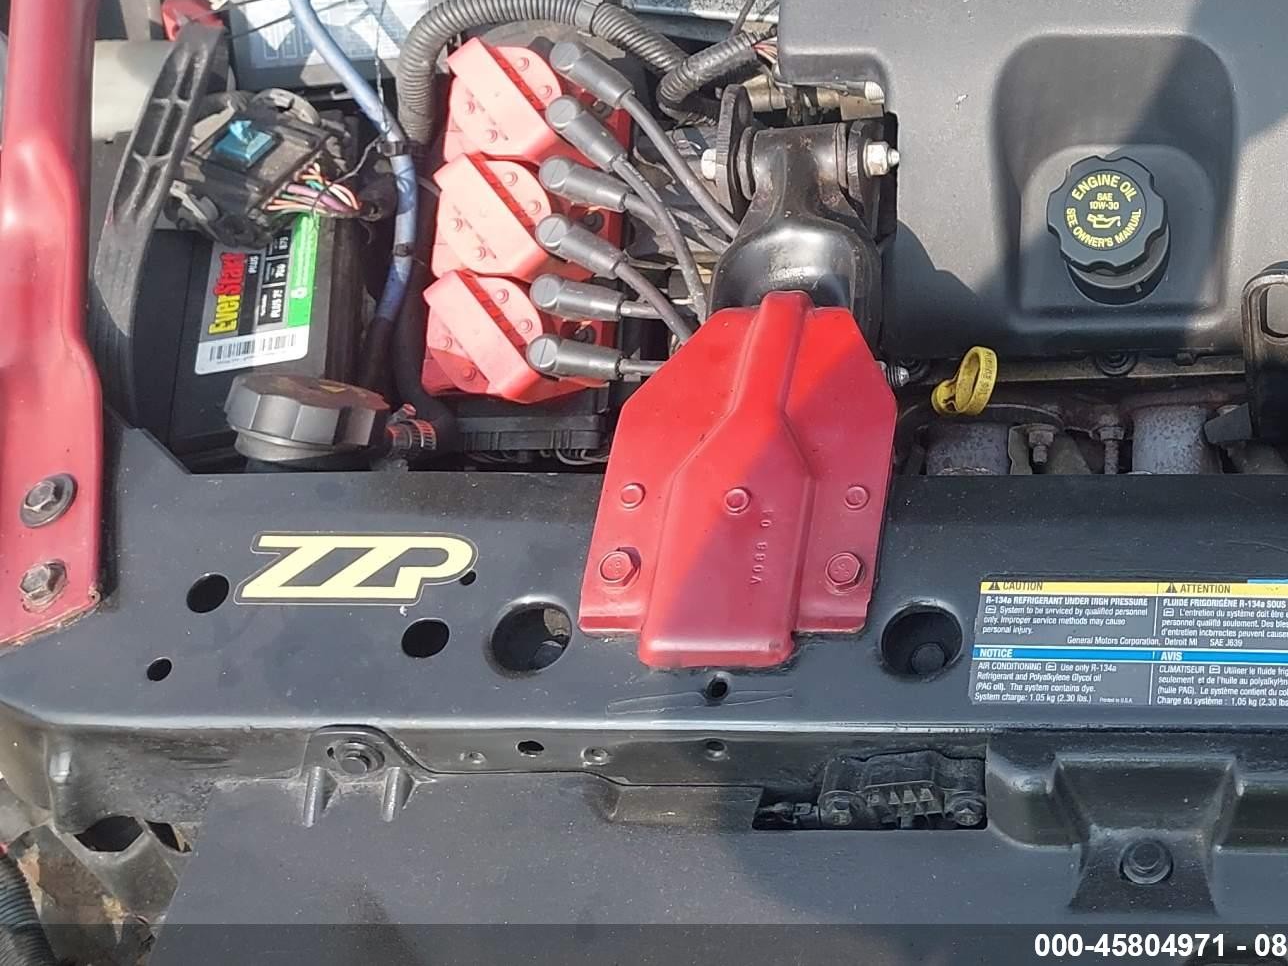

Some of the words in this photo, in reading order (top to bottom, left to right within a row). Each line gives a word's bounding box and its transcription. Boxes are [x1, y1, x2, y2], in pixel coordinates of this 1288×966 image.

[1072, 174, 1120, 201] ENGINE
[1120, 182, 1137, 202] OIL
[1097, 193, 1113, 201] SAE
[1089, 202, 1119, 210] 10W-30
[1066, 208, 1078, 228] SEE
[1073, 226, 1114, 247] OWNER'S
[1114, 209, 1141, 244] MANUAL
[248, 255, 259, 274] PLUS
[208, 252, 246, 335] EverStart
[241, 535, 473, 599] ZZP
[1003, 582, 1043, 591] CAUTION
[1180, 585, 1231, 593] ATTENTION
[986, 596, 1012, 605] R-134a
[1013, 596, 1063, 605] REFRIGERANT
[1064, 597, 1090, 605] UNDER
[1091, 597, 1109, 606] HIGH
[1110, 598, 1148, 606] PRESSURE
[1163, 598, 1188, 606] FLUIDE
[1239, 600, 1265, 608] R-134a
[1266, 600, 1286, 608] SOUS
[999, 606, 1024, 615] System
[1026, 606, 1033, 614] to
[1035, 606, 1043, 614] be
[1045, 606, 1073, 615] serviced
[1075, 606, 1083, 616] by
[1085, 606, 1113, 616] qualified
[1113, 608, 1148, 616] personnel
[1180, 608, 1214, 617] L'entretien
[1216, 609, 1225, 617] du
[1227, 609, 1255, 618] système
[1256, 609, 1269, 617] doit
[1271, 609, 1285, 618] être
[983, 616, 1000, 625] only.
[1001, 616, 1031, 626] Improper
[1032, 617, 1057, 625] service
[1058, 617, 1088, 625] methods
[1089, 618, 1104, 627] may
[1162, 619, 1195, 628] personnel
[1222, 619, 1259, 627] seulement.
[1261, 620, 1274, 628] Des
[982, 625, 1011, 635] personal
[1013, 626, 1033, 635] injury.
[1161, 628, 1198, 636] d'entretien
[1199, 629, 1236, 637] incorrectes
[1238, 630, 1265, 639] peuvent
[1067, 636, 1093, 644] General
[1094, 636, 1118, 645] Motors
[1120, 636, 1161, 646] Corporation,
[1164, 638, 1187, 646] Detroit
[1189, 638, 1198, 646] MI
[1209, 638, 1224, 647] SAE
[1225, 639, 1243, 647] J639
[980, 649, 1012, 658] NOTICE
[1160, 652, 1182, 661] AVIS
[978, 662, 990, 670] AIR
[991, 662, 1042, 671] CONDITIONING
[1060, 664, 1073, 672] Use
[1075, 664, 1090, 673] only
[1091, 664, 1117, 672] R-134a
[1159, 665, 1204, 673] CLIMATISEUR
[1224, 667, 1248, 675] Utiliser
[1249, 667, 1255, 675] le
[1257, 667, 1276, 676] fluide
[977, 672, 1014, 681] Refrigerant
[1029, 673, 1070, 682] Polyalkylene
[1072, 673, 1092, 682] Glycol
[1093, 674, 1101, 682] oil
[1158, 676, 1194, 684] seulement
[1198, 676, 1205, 684] et
[1206, 676, 1215, 684] de
[1217, 676, 1237, 684] l'huile
[976, 683, 992, 691] (PAG
[1010, 683, 1022, 691] The
[1025, 684, 1049, 693] system
[1051, 684, 1080, 692] contains
[1081, 684, 1095, 693] dye.
[1158, 686, 1176, 695] (huile
[1178, 686, 1197, 695] PAG).
[1200, 687, 1209, 695] Le
[1210, 687, 1238, 697] système
[1240, 688, 1266, 696] contient
[1268, 688, 1277, 696] du
[975, 692, 1000, 702] System
[1002, 693, 1028, 703] charge:
[1029, 694, 1045, 702] 1.05
[1046, 694, 1055, 703] kg
[1057, 694, 1075, 703] (2.30
[1077, 694, 1092, 703] lbs.)
[1157, 697, 1182, 707] Charge
[1183, 697, 1192, 705] du
[1194, 697, 1223, 707] système
[1248, 698, 1257, 707] kg
